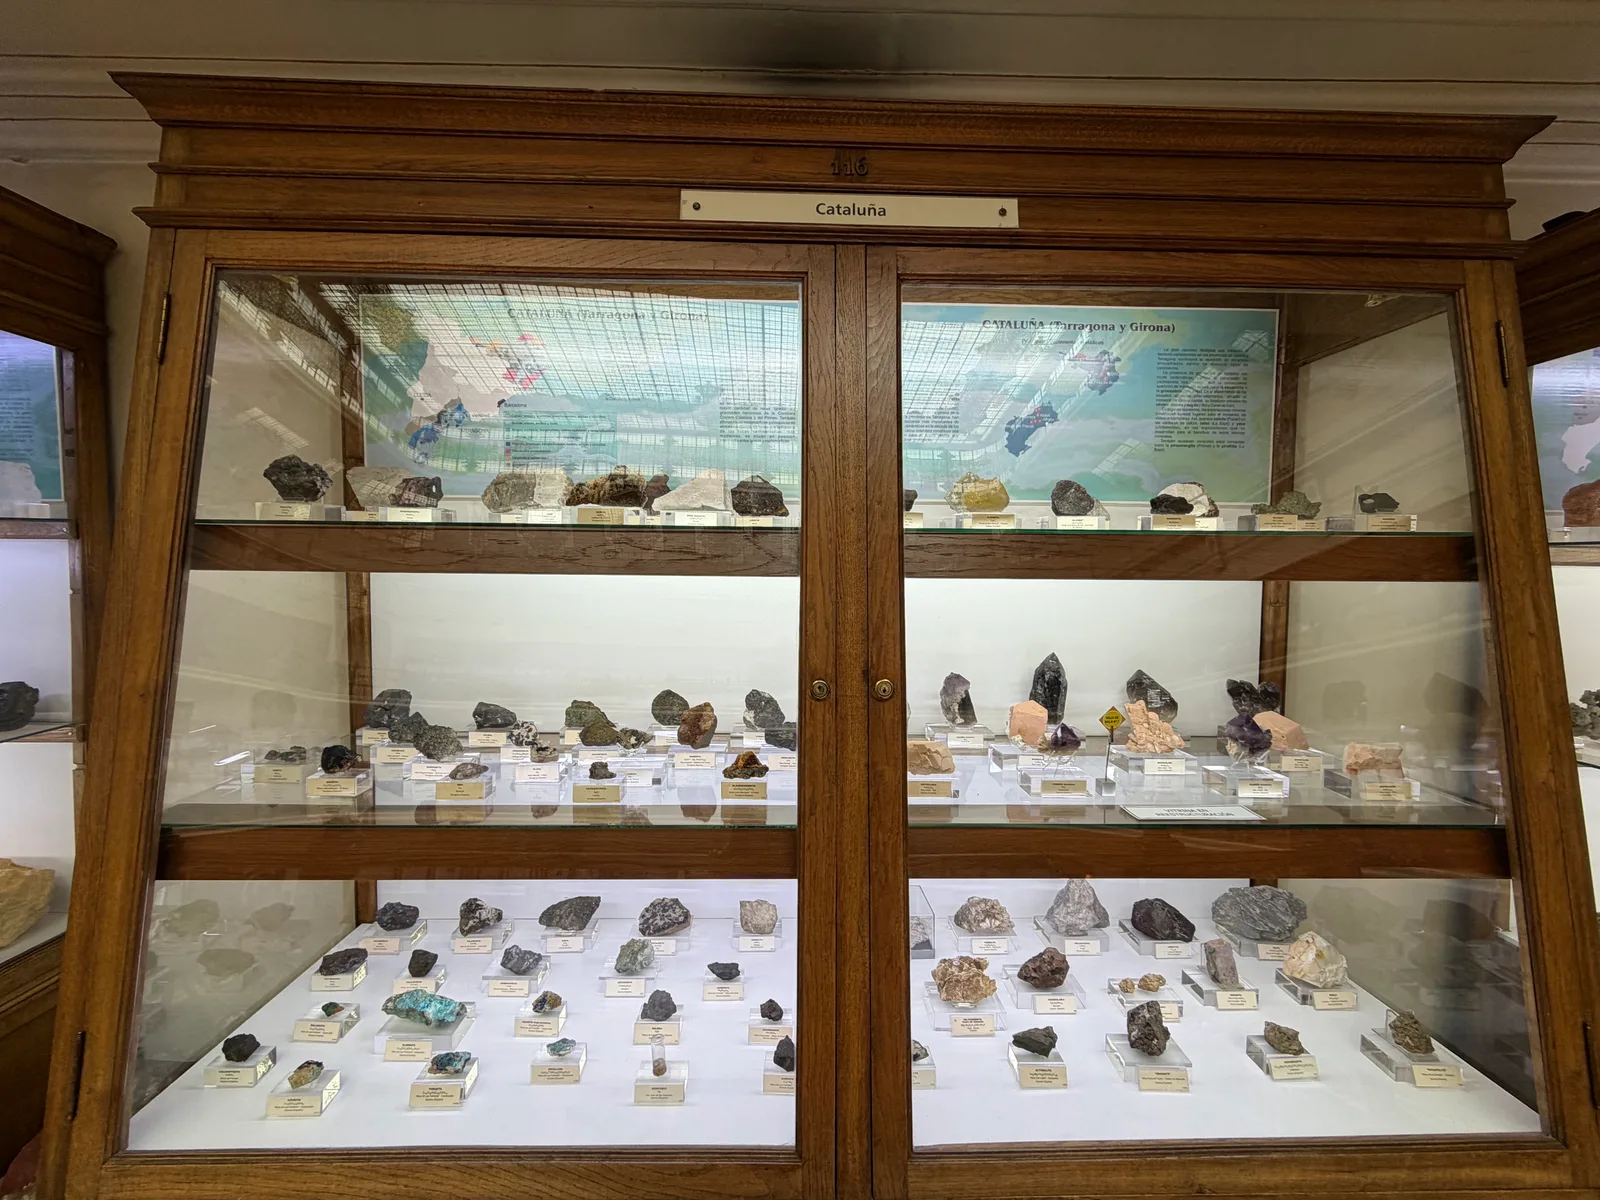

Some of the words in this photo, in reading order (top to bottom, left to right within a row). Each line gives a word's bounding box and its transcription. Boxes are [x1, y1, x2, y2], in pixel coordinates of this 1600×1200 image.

[830, 156, 869, 177] 116
[815, 202, 887, 217] Cataluña
[982, 318, 1045, 330] CATALUÑA
[1049, 321, 1116, 333] (Tarragona
[1119, 324, 1126, 334] y
[1130, 322, 1176, 334] Girona)
